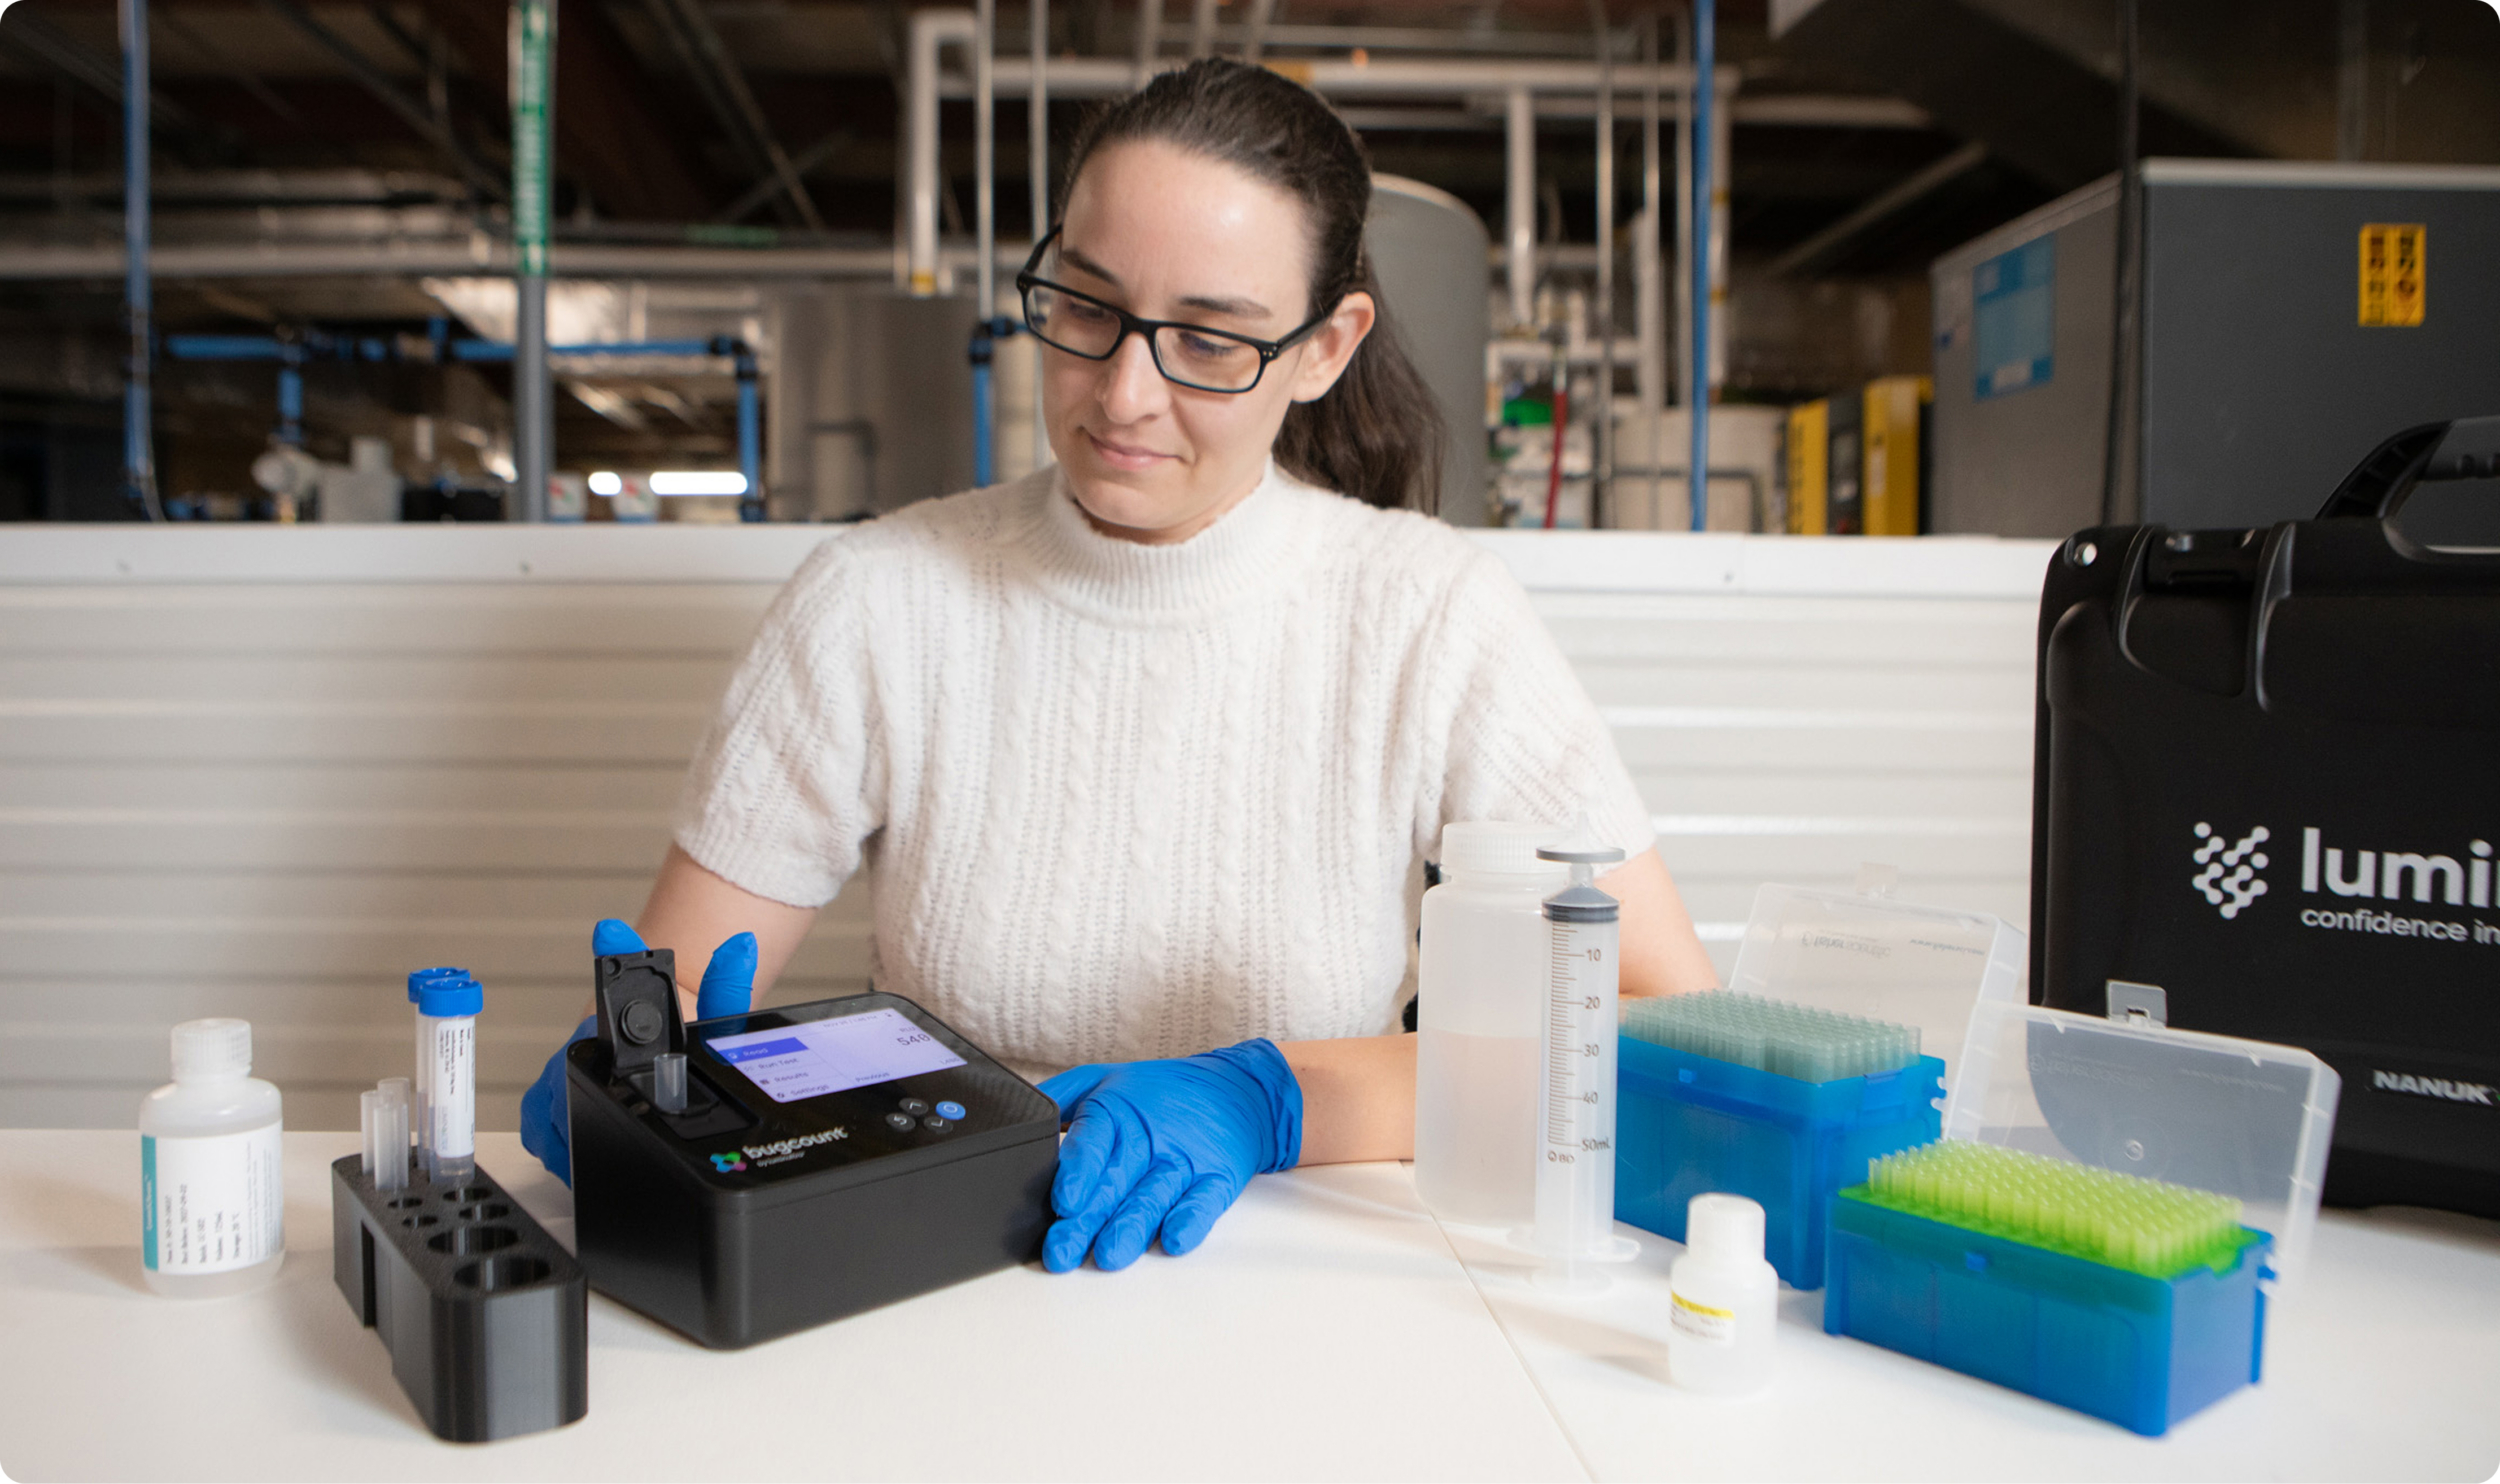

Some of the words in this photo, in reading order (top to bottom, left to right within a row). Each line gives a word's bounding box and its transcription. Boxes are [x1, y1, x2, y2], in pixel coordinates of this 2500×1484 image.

[2302, 827, 2500, 909] lumi
[2301, 908, 2469, 942] confidence
[1586, 949, 1601, 962] 10
[1584, 997, 1601, 1010] 20
[896, 1033, 931, 1047] 540
[743, 1047, 769, 1057] Read
[1584, 1045, 1600, 1058] 30
[758, 1062, 777, 1070] Run
[779, 1058, 799, 1066] Test
[774, 1072, 809, 1083] Results
[790, 1084, 830, 1096] Settings
[2373, 1069, 2493, 1106] NANUK
[1583, 1092, 1599, 1105] 40
[742, 1125, 848, 1160] bugcount
